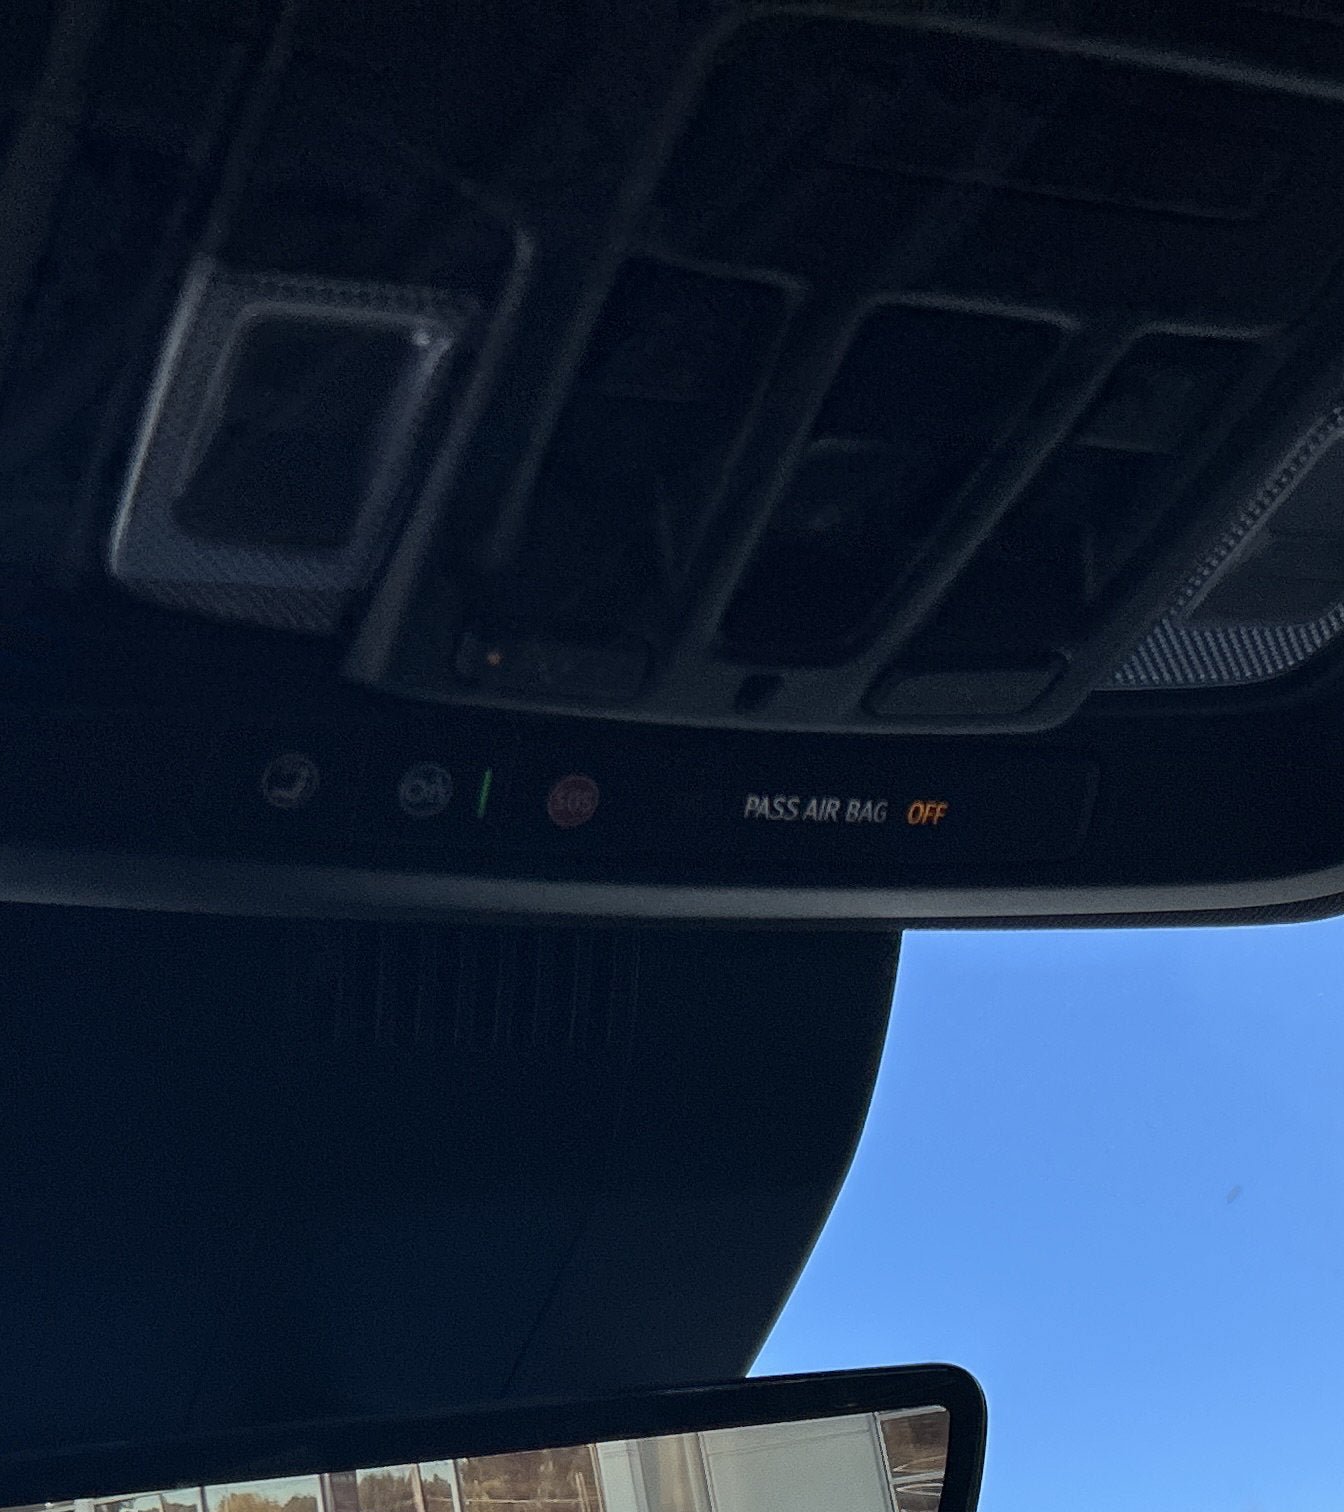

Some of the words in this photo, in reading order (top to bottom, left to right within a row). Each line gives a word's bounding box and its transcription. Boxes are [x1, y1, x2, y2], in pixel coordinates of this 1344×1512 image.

[744, 794, 800, 821] PASS
[803, 797, 841, 821] AIR
[845, 799, 888, 823] BAG
[907, 800, 949, 825] OFF
